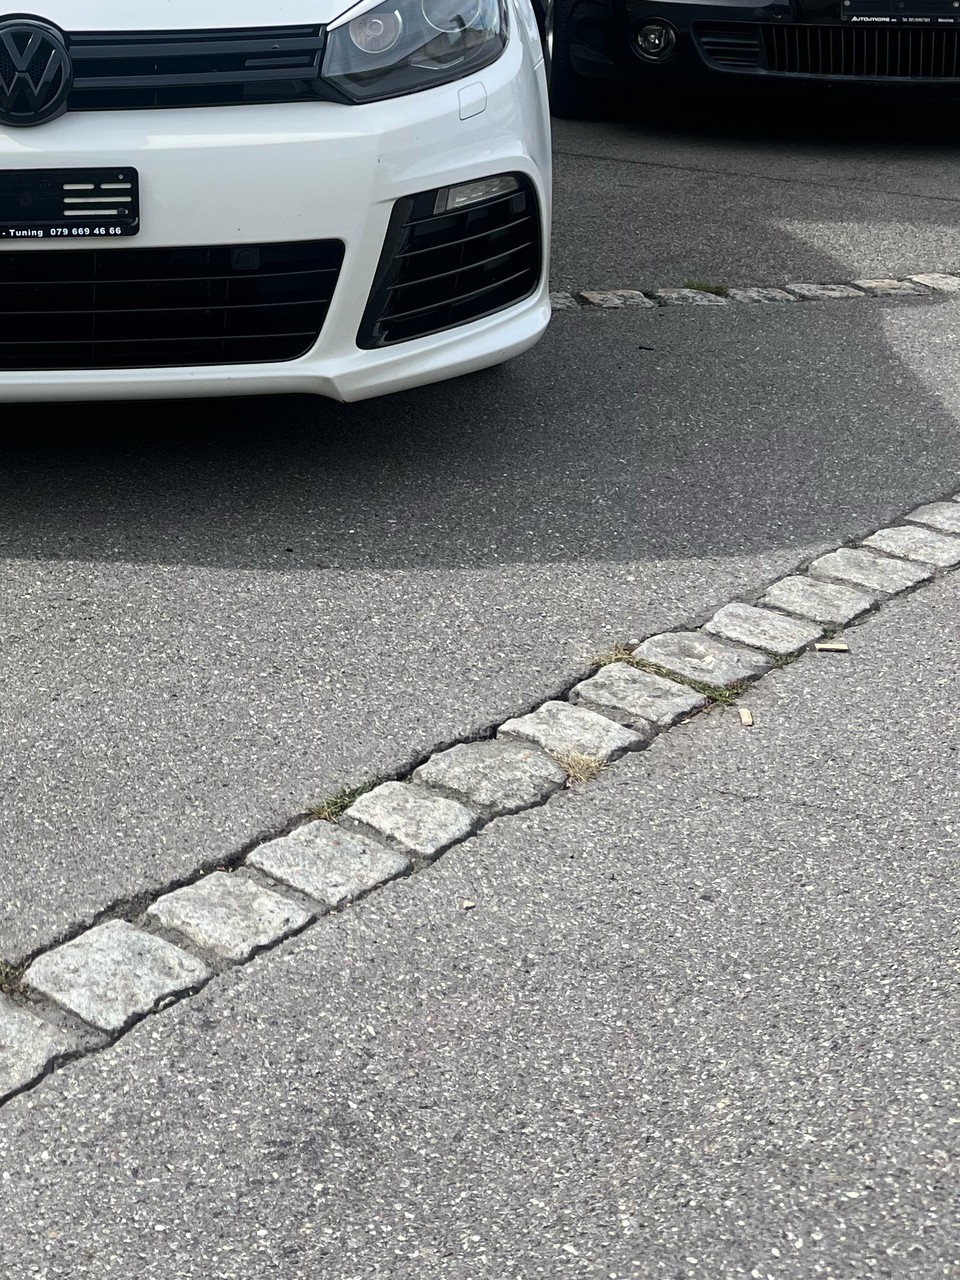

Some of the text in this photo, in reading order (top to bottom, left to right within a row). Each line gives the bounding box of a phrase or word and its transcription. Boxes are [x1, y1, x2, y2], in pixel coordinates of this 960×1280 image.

[9, 228, 43, 238] Tuning
[50, 228, 68, 236] 079
[72, 227, 90, 235] 669
[93, 227, 106, 235] 46
[109, 226, 122, 235] 66
